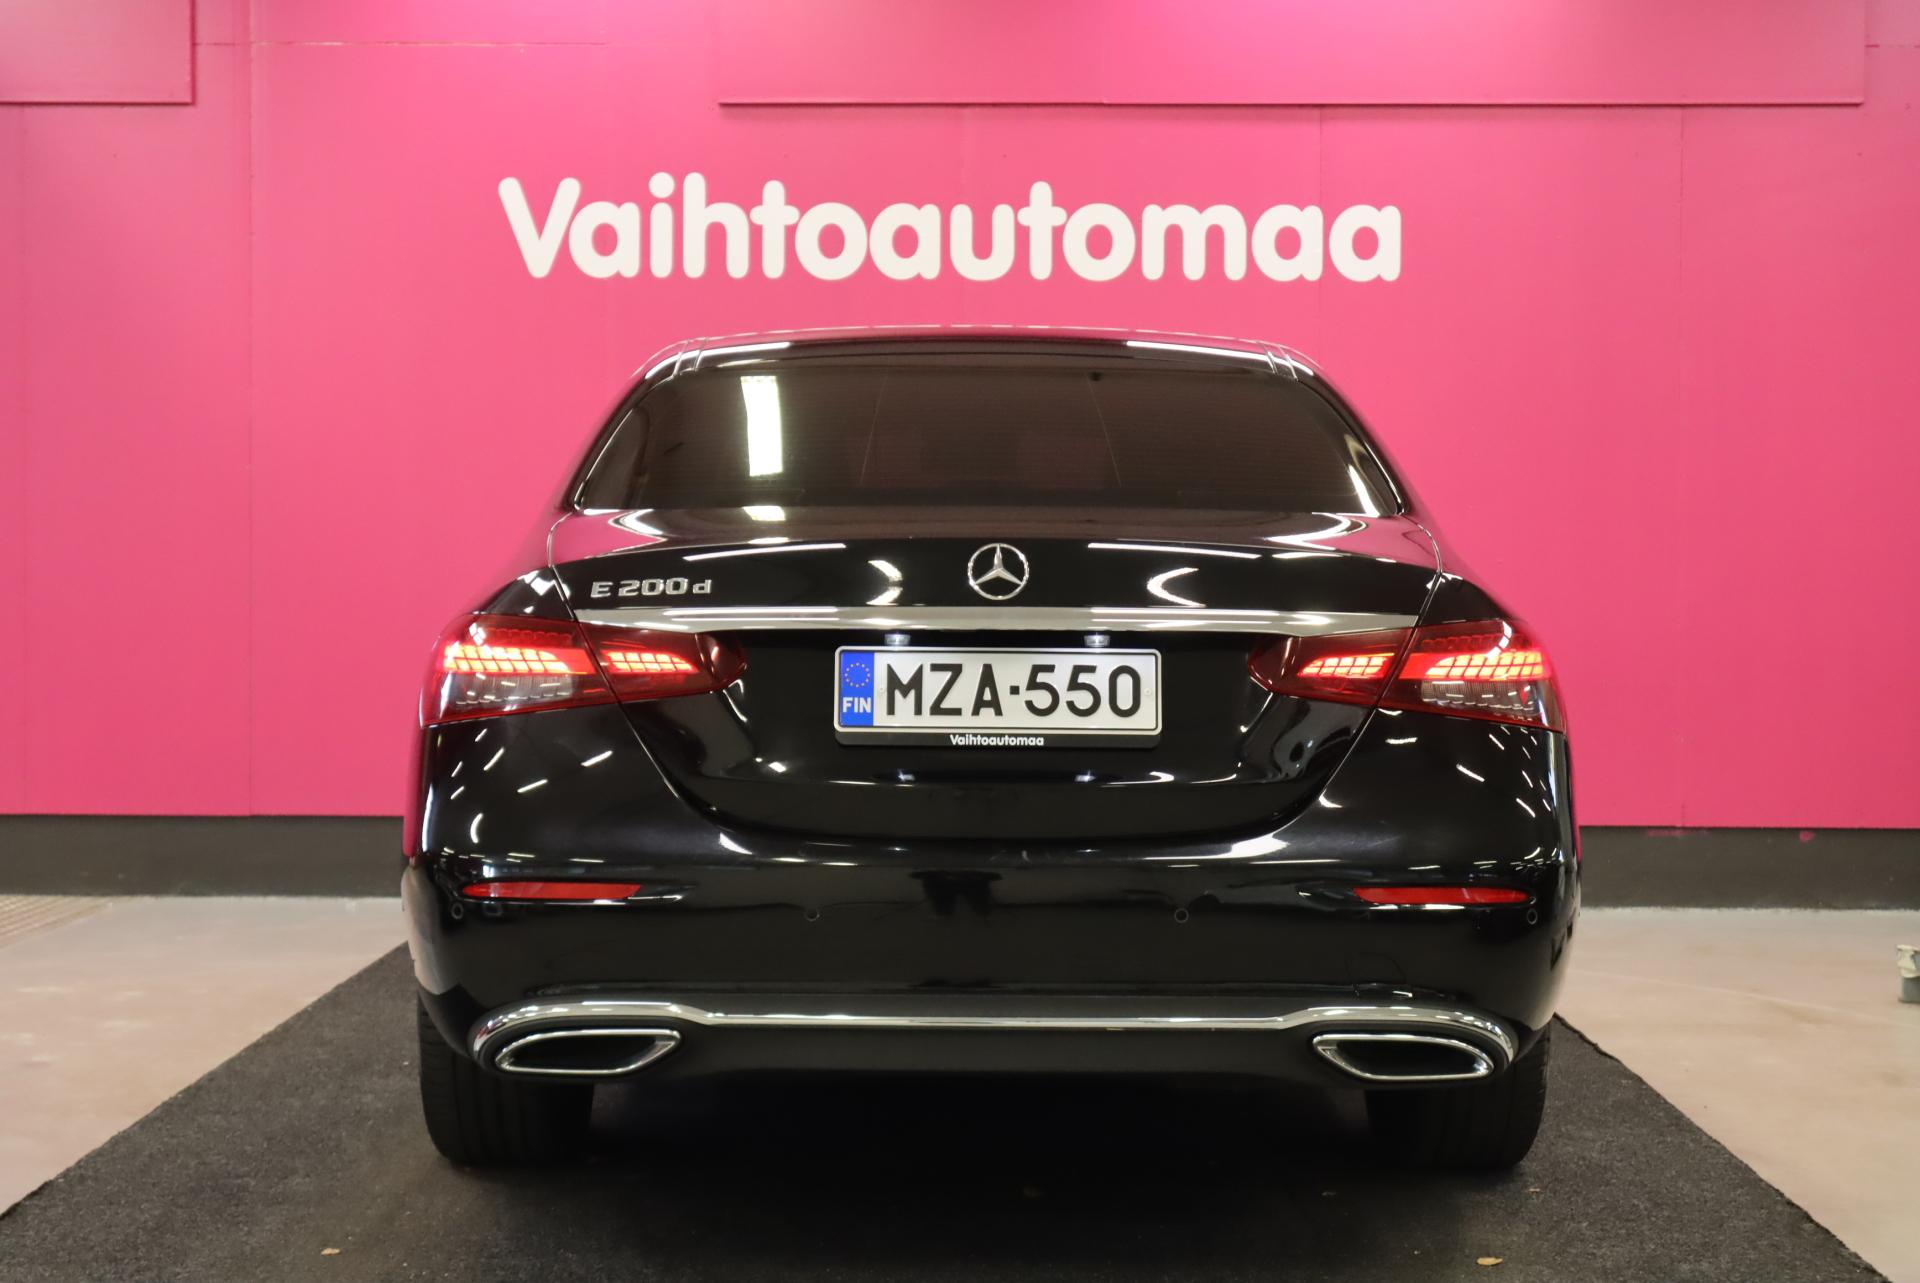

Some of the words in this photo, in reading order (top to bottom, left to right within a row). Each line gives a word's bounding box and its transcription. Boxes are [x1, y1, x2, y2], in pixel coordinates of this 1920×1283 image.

[498, 171, 1402, 283] Vaihtoautomaa
[590, 581, 613, 599] E
[842, 696, 872, 714] FIN
[949, 733, 1045, 747] Vaihtoautomaa
